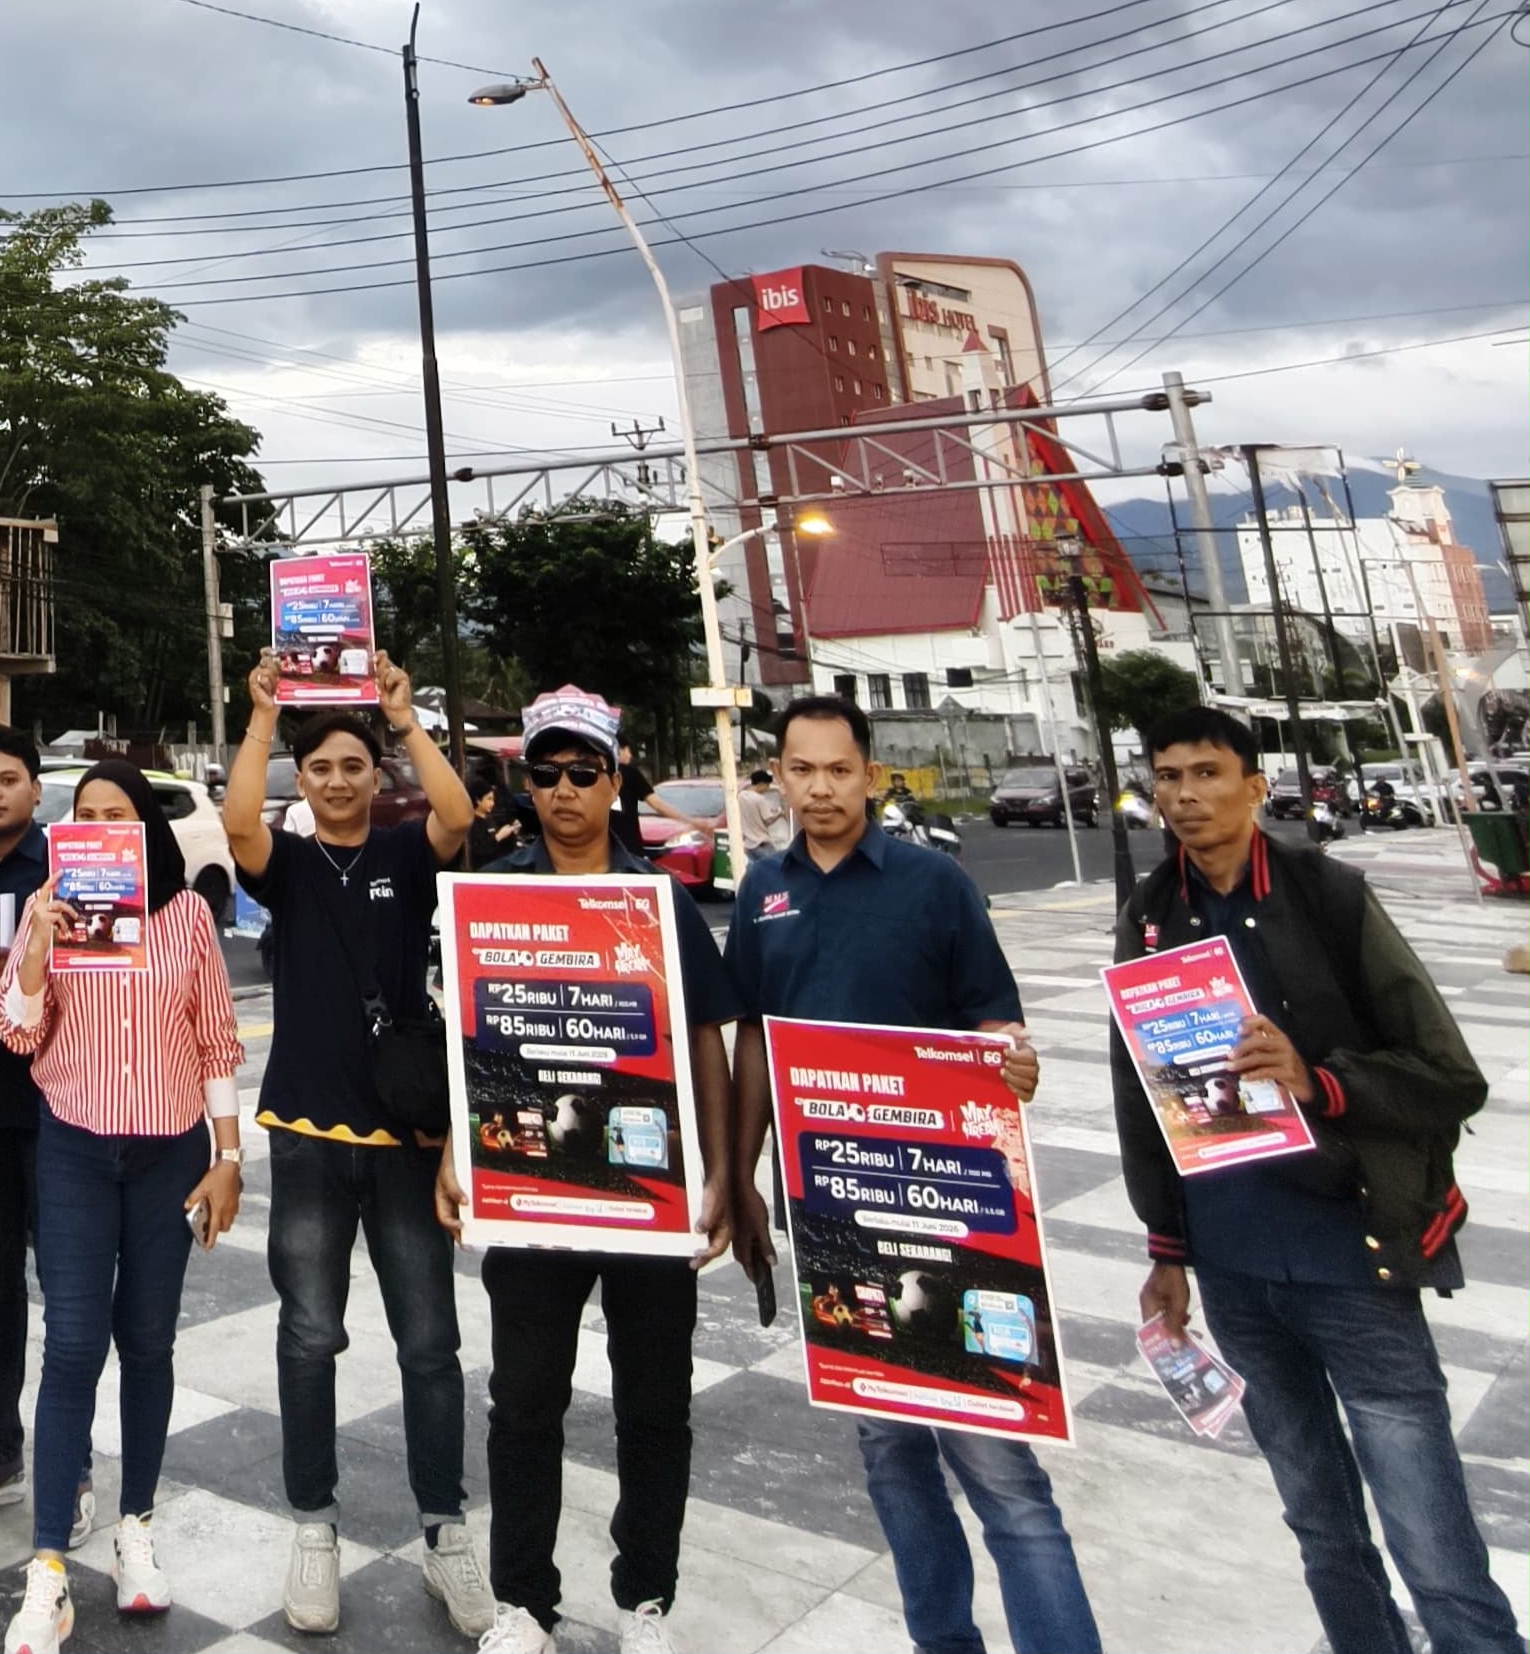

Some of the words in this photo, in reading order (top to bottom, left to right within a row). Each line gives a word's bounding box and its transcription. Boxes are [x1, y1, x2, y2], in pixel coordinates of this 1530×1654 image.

[761, 283, 799, 311] ibis
[578, 898, 628, 910] Telkomsel
[469, 922, 530, 941] DAPATKAN
[533, 924, 569, 942] PAKET
[483, 951, 517, 963] BOLA
[539, 952, 595, 966] GEMBIRA
[914, 1046, 974, 1062] Telkomsel
[789, 1067, 860, 1092] DAPATKAN
[863, 1074, 905, 1096] PAKET
[808, 1101, 846, 1118] BOLA
[872, 1107, 938, 1126] GEMBIRA
[877, 1240, 899, 1257] BELI
